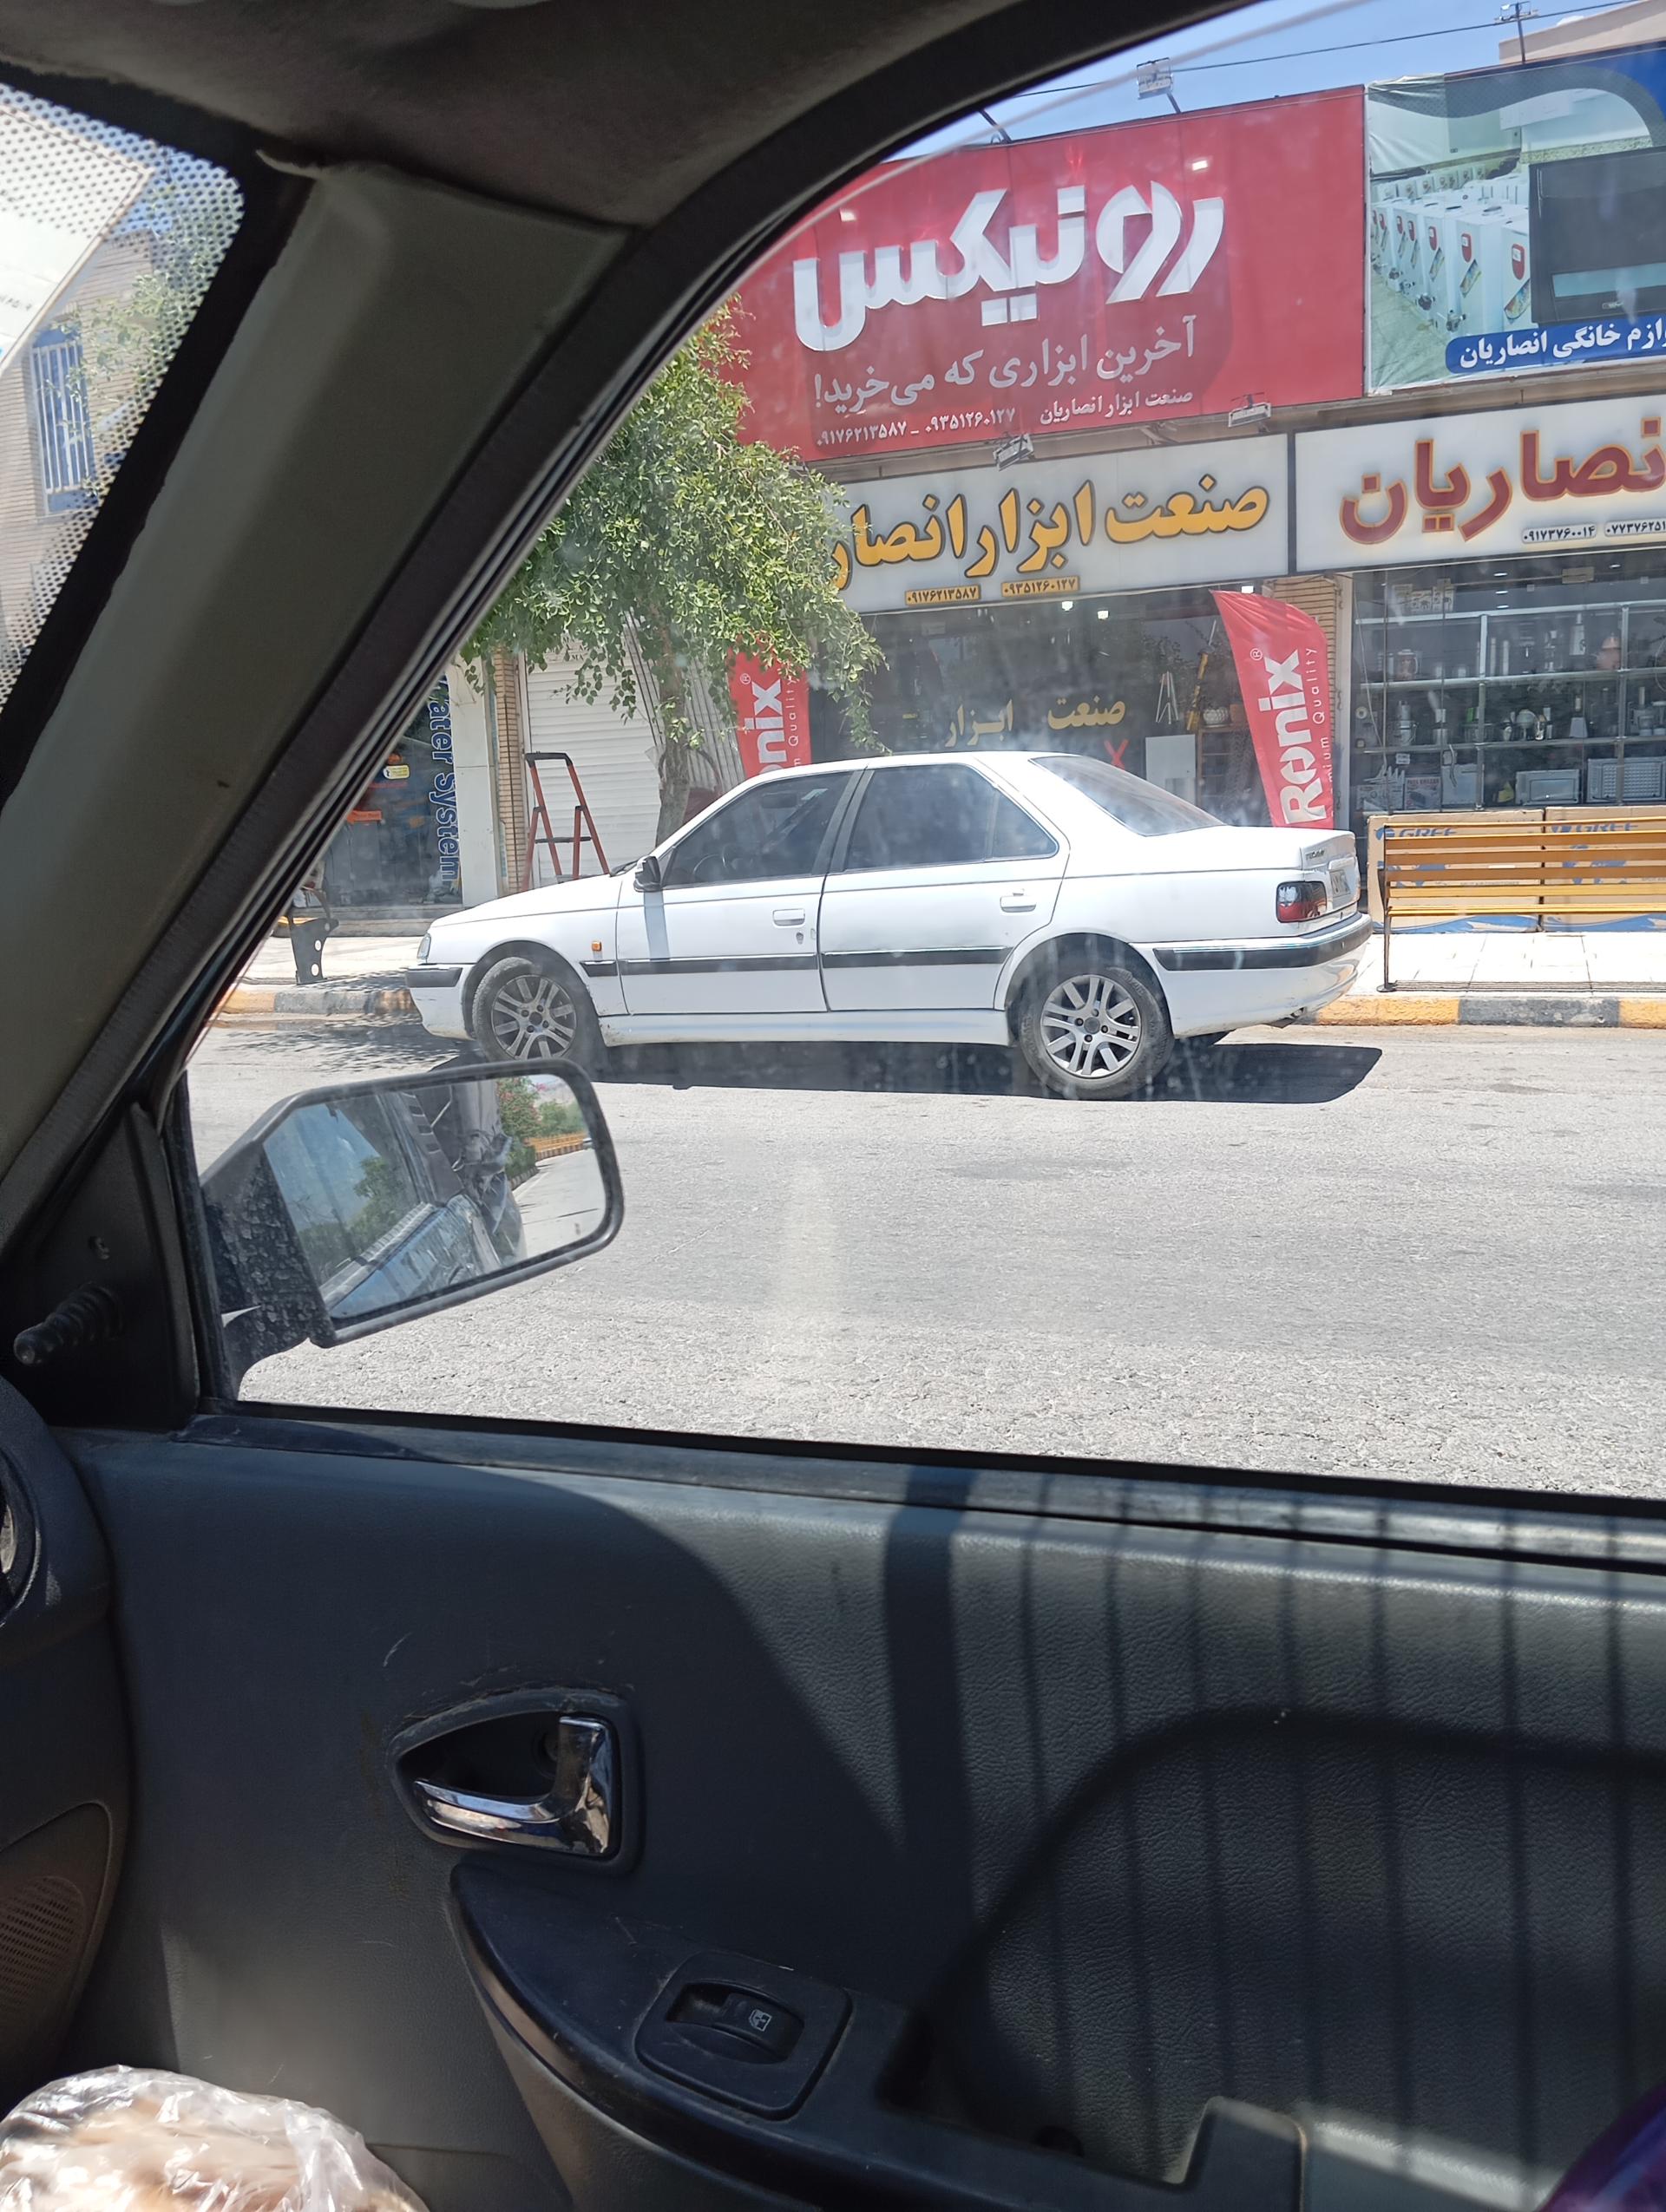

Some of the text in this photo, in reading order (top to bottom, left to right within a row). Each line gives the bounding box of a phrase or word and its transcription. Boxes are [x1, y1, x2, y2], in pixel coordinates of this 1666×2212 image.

[793, 180, 1224, 351] رونیکس
[944, 350, 984, 385] که
[989, 334, 1088, 388] ابزاری
[1096, 315, 1197, 383] آخرین
[1460, 317, 1666, 368] ازم خانگی انصاریان
[1040, 389, 1193, 424] صنعت ابزار انصاریان
[1339, 416, 1666, 545] نصاریان
[830, 473, 1270, 592] صنعت ابزار انصار
[1606, 520, 1666, 534] ۰۷۷۳۷۶۲۵۱
[944, 695, 1125, 748] صنعت ابزار
[1306, 647, 1325, 725] Quality
[744, 678, 787, 774] nix
[1258, 649, 1327, 824] Ronix
[430, 771, 460, 882] System
